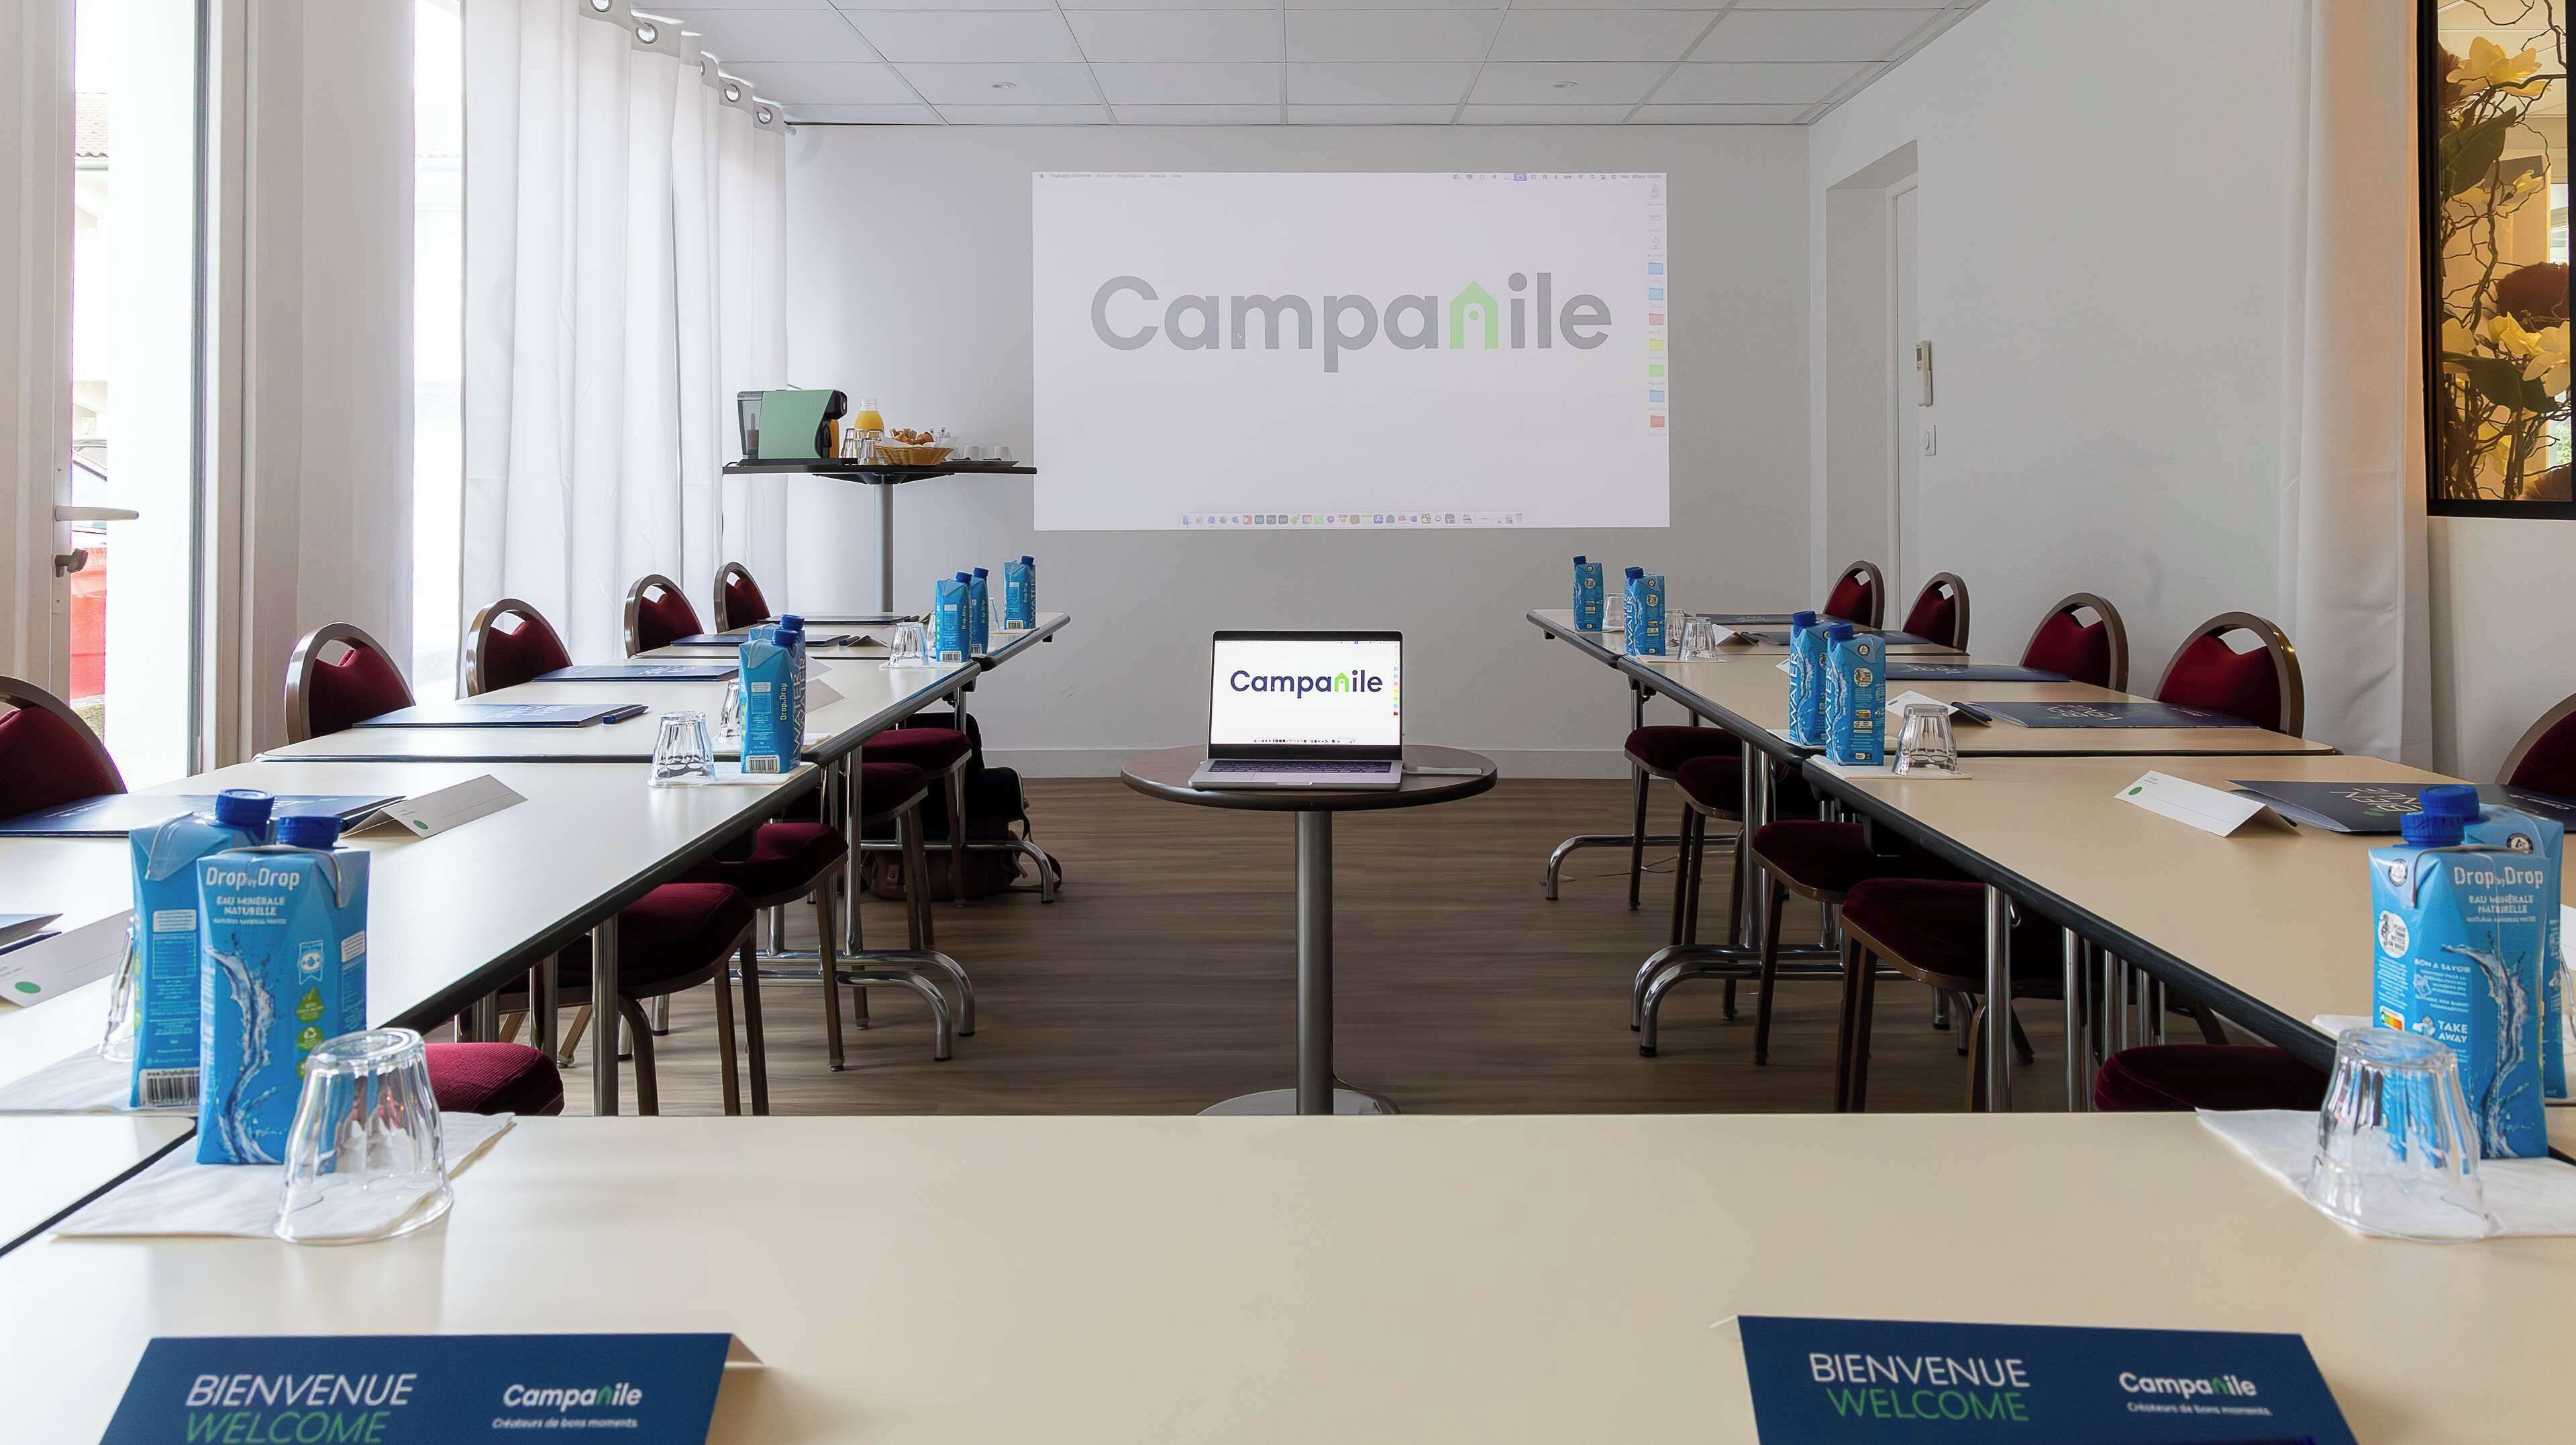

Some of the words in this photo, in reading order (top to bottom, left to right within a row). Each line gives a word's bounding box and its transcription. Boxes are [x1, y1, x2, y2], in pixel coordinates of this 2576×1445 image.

[1090, 272, 1612, 372] Campanile
[1230, 669, 1383, 699] Campanile
[1790, 652, 1798, 726] WATER
[206, 866, 247, 891] Drop
[257, 867, 300, 891] Drop
[2454, 866, 2493, 889] Drop
[2504, 866, 2544, 889] Drop
[216, 895, 235, 905] EAU
[224, 907, 276, 915] NATURELLE
[2469, 895, 2487, 903] EAU
[2438, 1019, 2468, 1034] TAKE
[2438, 1032, 2468, 1043] AWAY
[1809, 1352, 2030, 1388] BIENVENUE
[185, 1373, 417, 1407] BIENVENUE
[504, 1382, 643, 1413] Campanile
[2118, 1372, 2257, 1400] Campanile
[1826, 1387, 2030, 1422] WELCOME
[2178, 1403, 2193, 1414] de
[2194, 1403, 2220, 1414] bons
[185, 1410, 391, 1444] WELCOME
[544, 1417, 559, 1429] de
[560, 1417, 586, 1428] bons
